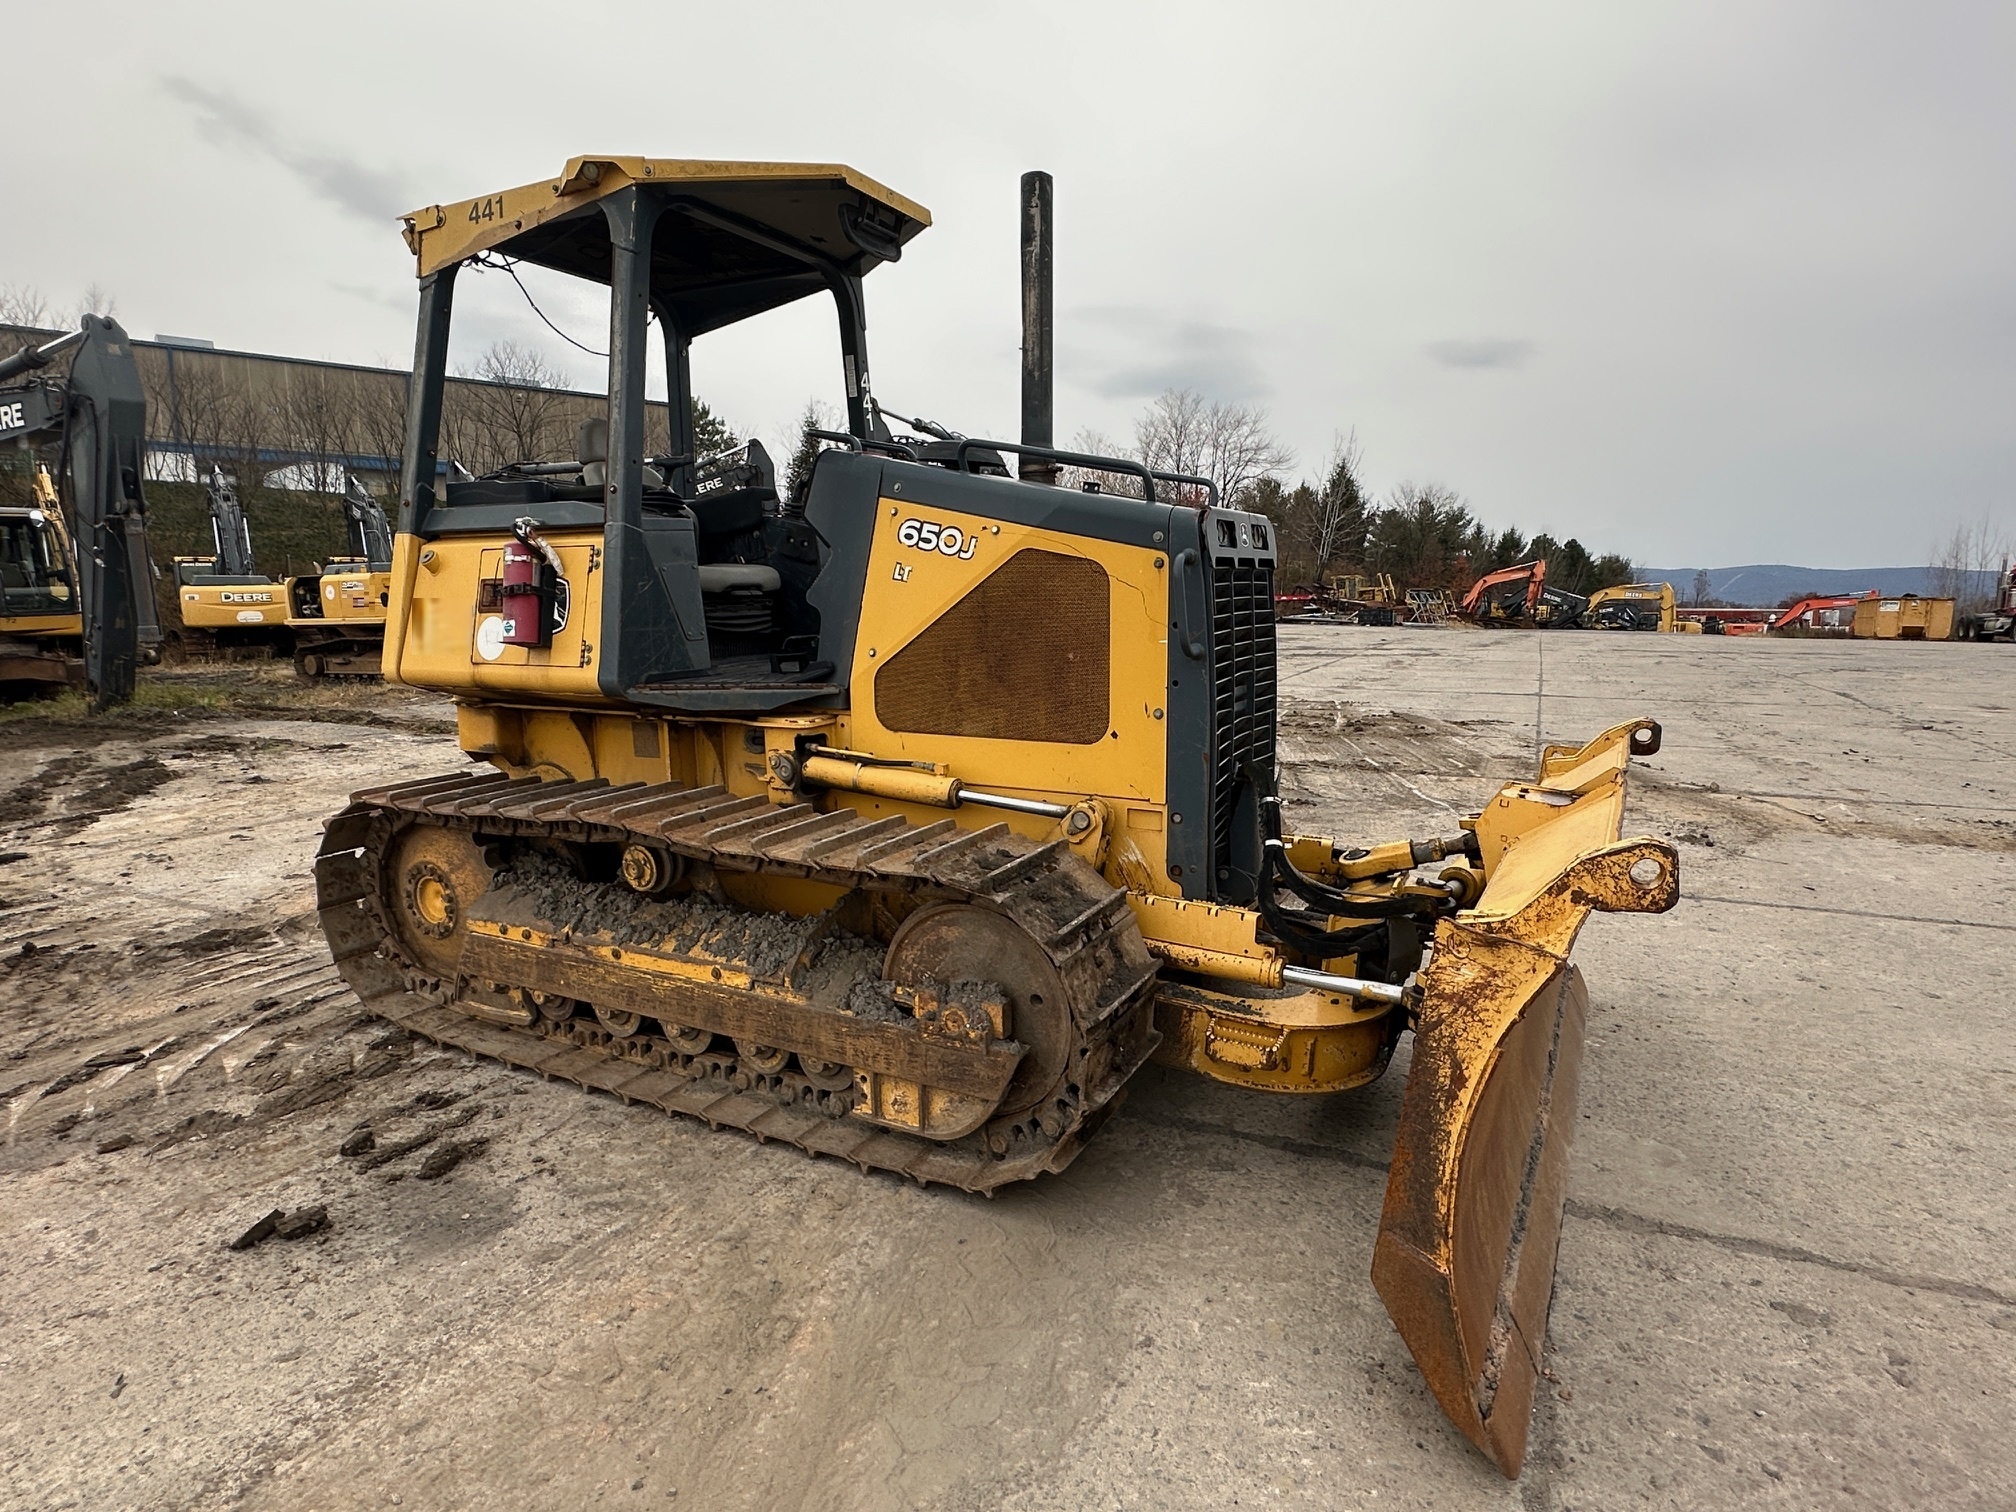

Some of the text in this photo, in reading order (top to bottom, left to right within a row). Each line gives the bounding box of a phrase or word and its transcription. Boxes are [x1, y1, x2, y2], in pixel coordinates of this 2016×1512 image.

[469, 195, 503, 225] 441
[0, 402, 25, 430] RE
[861, 371, 874, 432] 441
[696, 476, 724, 494] ERE
[898, 518, 978, 560] 650J
[221, 592, 272, 602] DEERE
